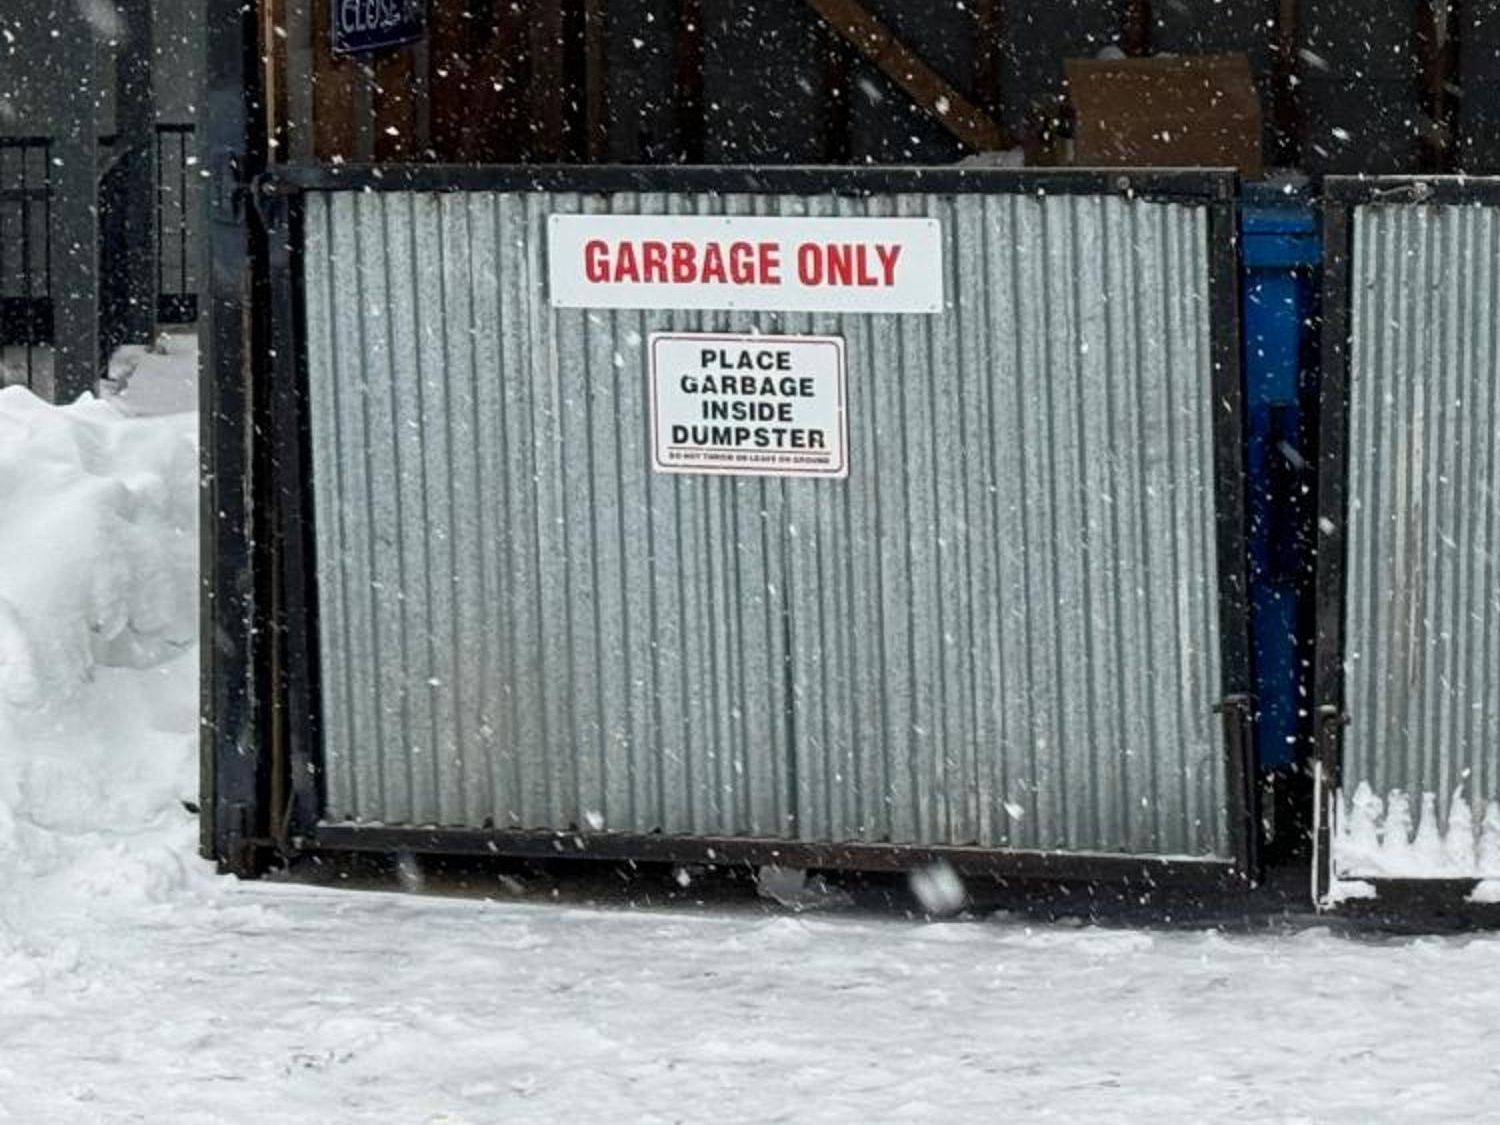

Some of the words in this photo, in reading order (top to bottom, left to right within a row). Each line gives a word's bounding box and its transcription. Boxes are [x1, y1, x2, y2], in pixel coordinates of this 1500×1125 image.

[584, 240, 781, 284] GARBAGE
[797, 242, 902, 286] ONLY
[702, 350, 791, 370] PLACE
[681, 375, 814, 397] GARBAGE
[703, 401, 792, 421] INSIDE
[671, 425, 825, 448] DUMPSTER
